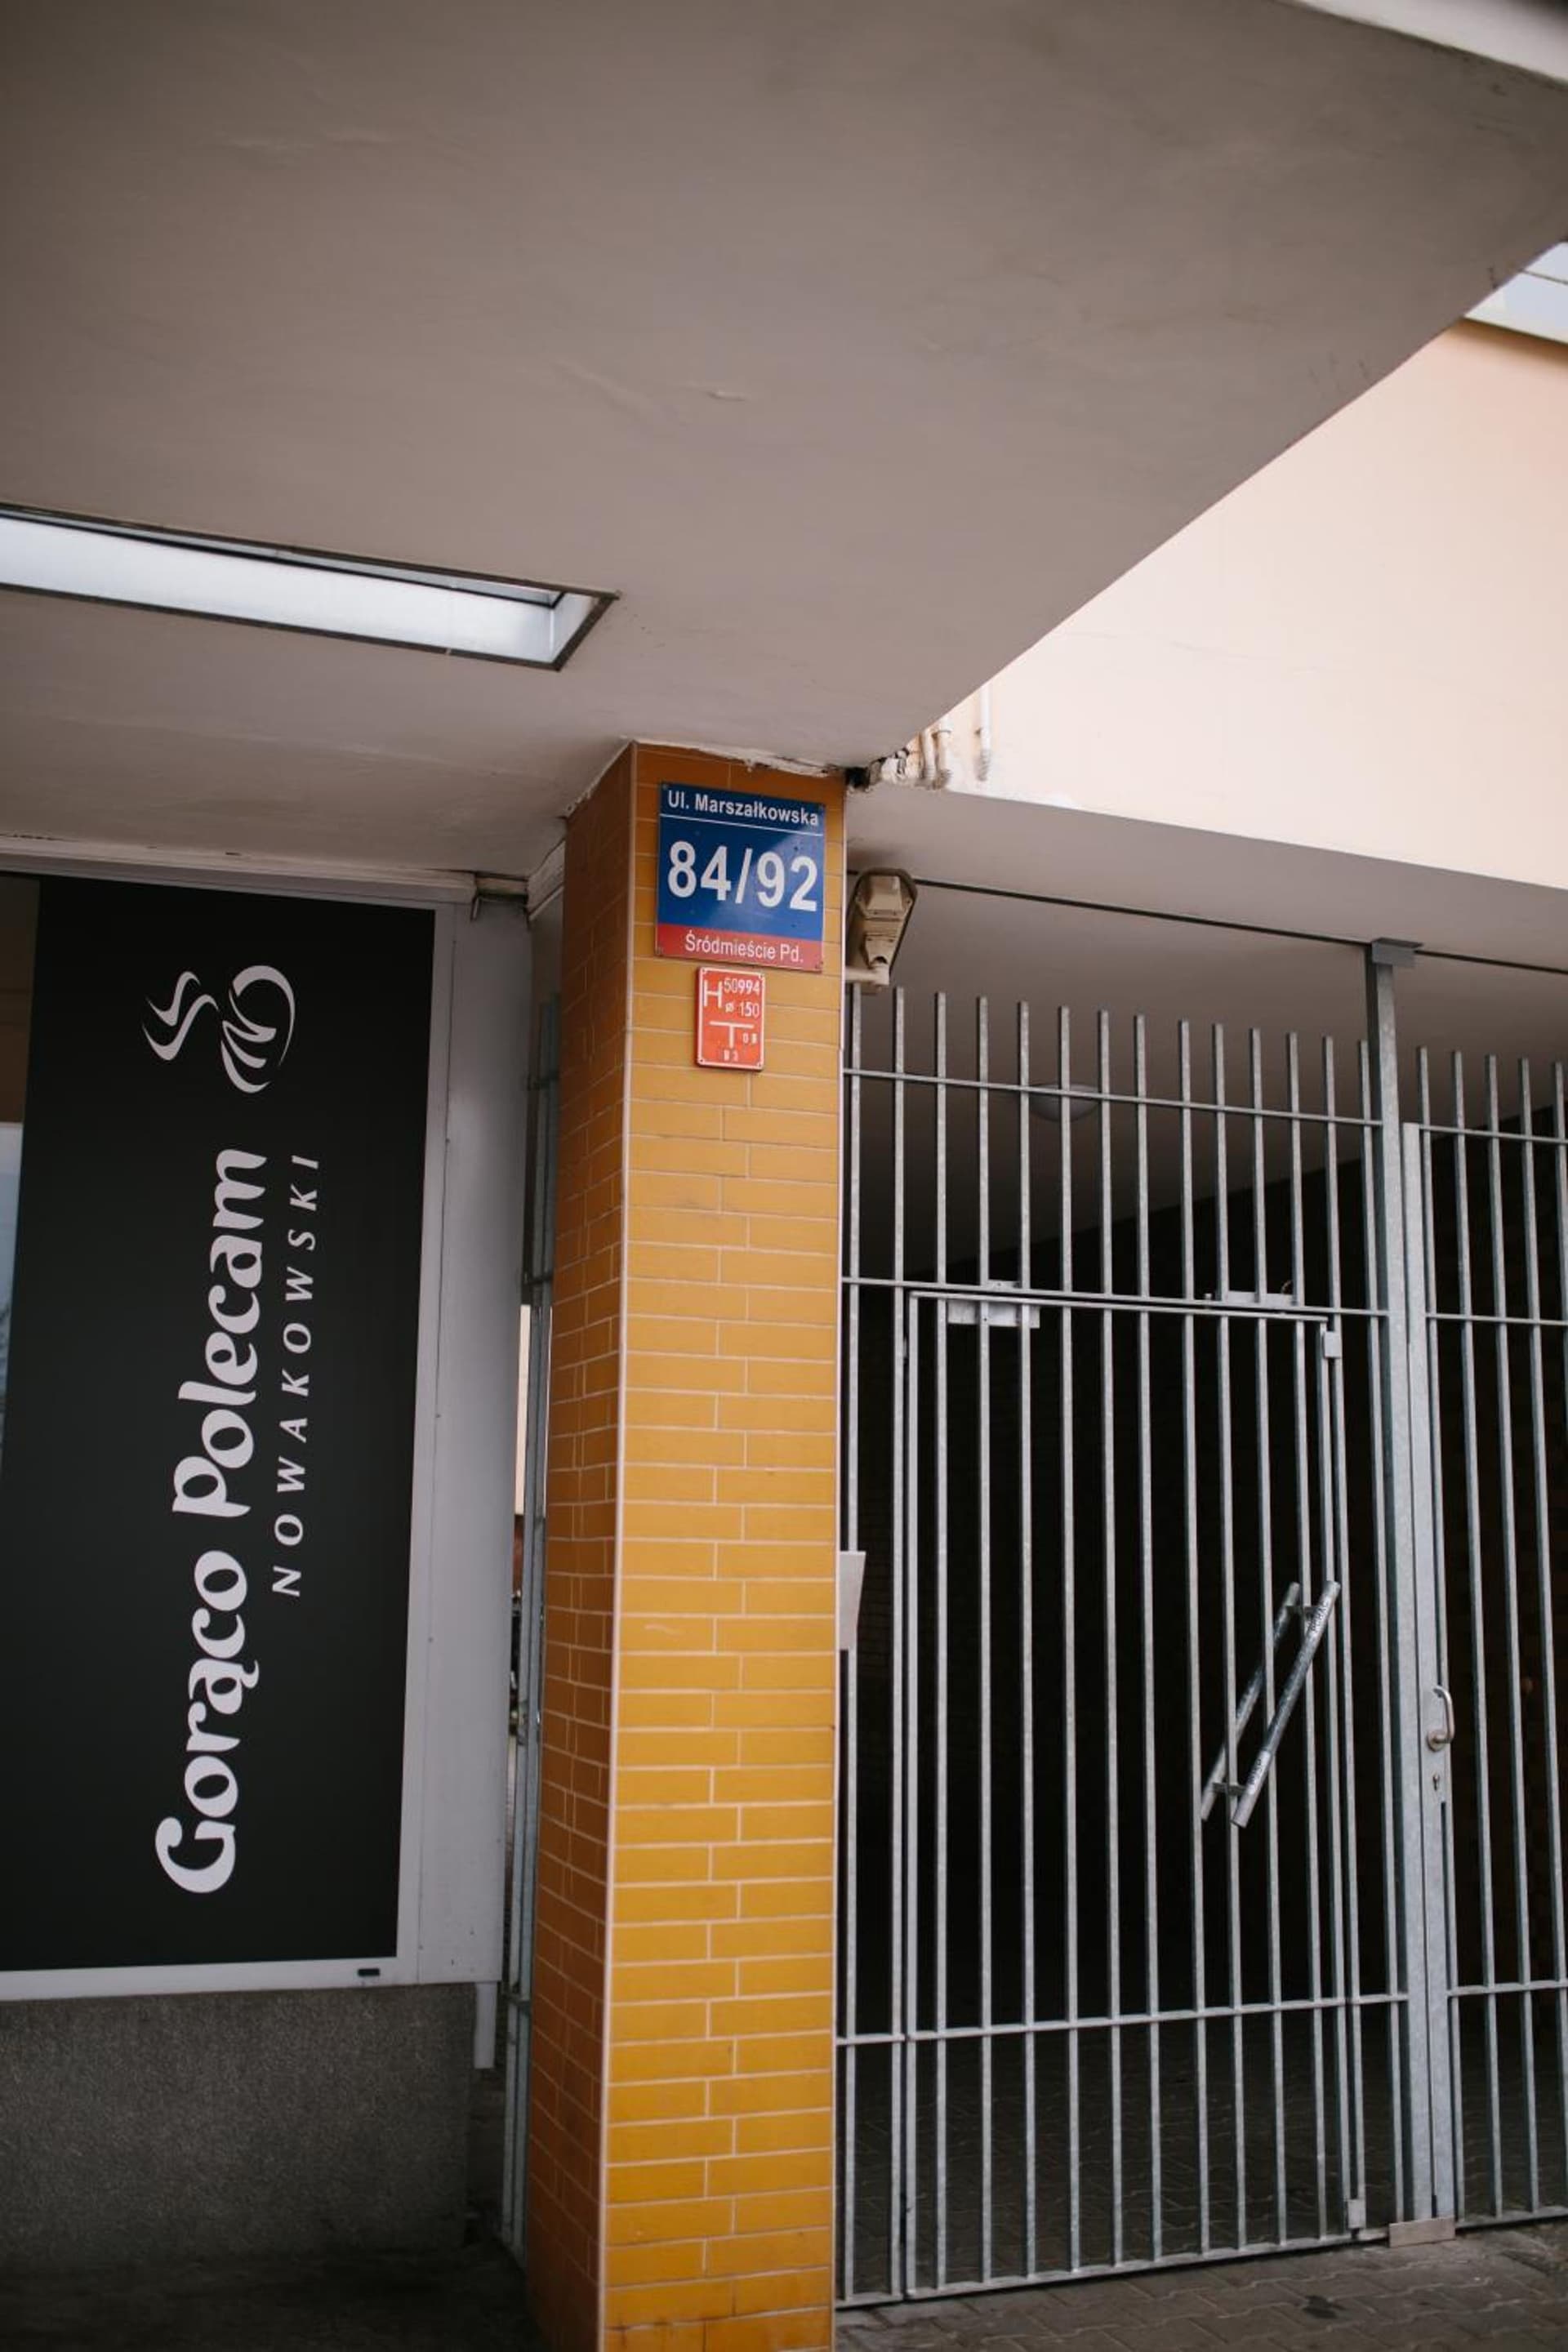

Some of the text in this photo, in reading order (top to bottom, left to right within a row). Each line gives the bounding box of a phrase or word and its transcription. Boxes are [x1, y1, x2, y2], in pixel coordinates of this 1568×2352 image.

[667, 790, 818, 826] Ul. Marszałkowska
[667, 840, 817, 912] 84/92
[685, 929, 804, 964] Śródmieście Pd.
[703, 978, 760, 1009] H 50994
[739, 1000, 760, 1018] 150
[272, 1155, 319, 1597] NOWAKOWSKI
[155, 1149, 267, 1894] Gorąco Polecam
